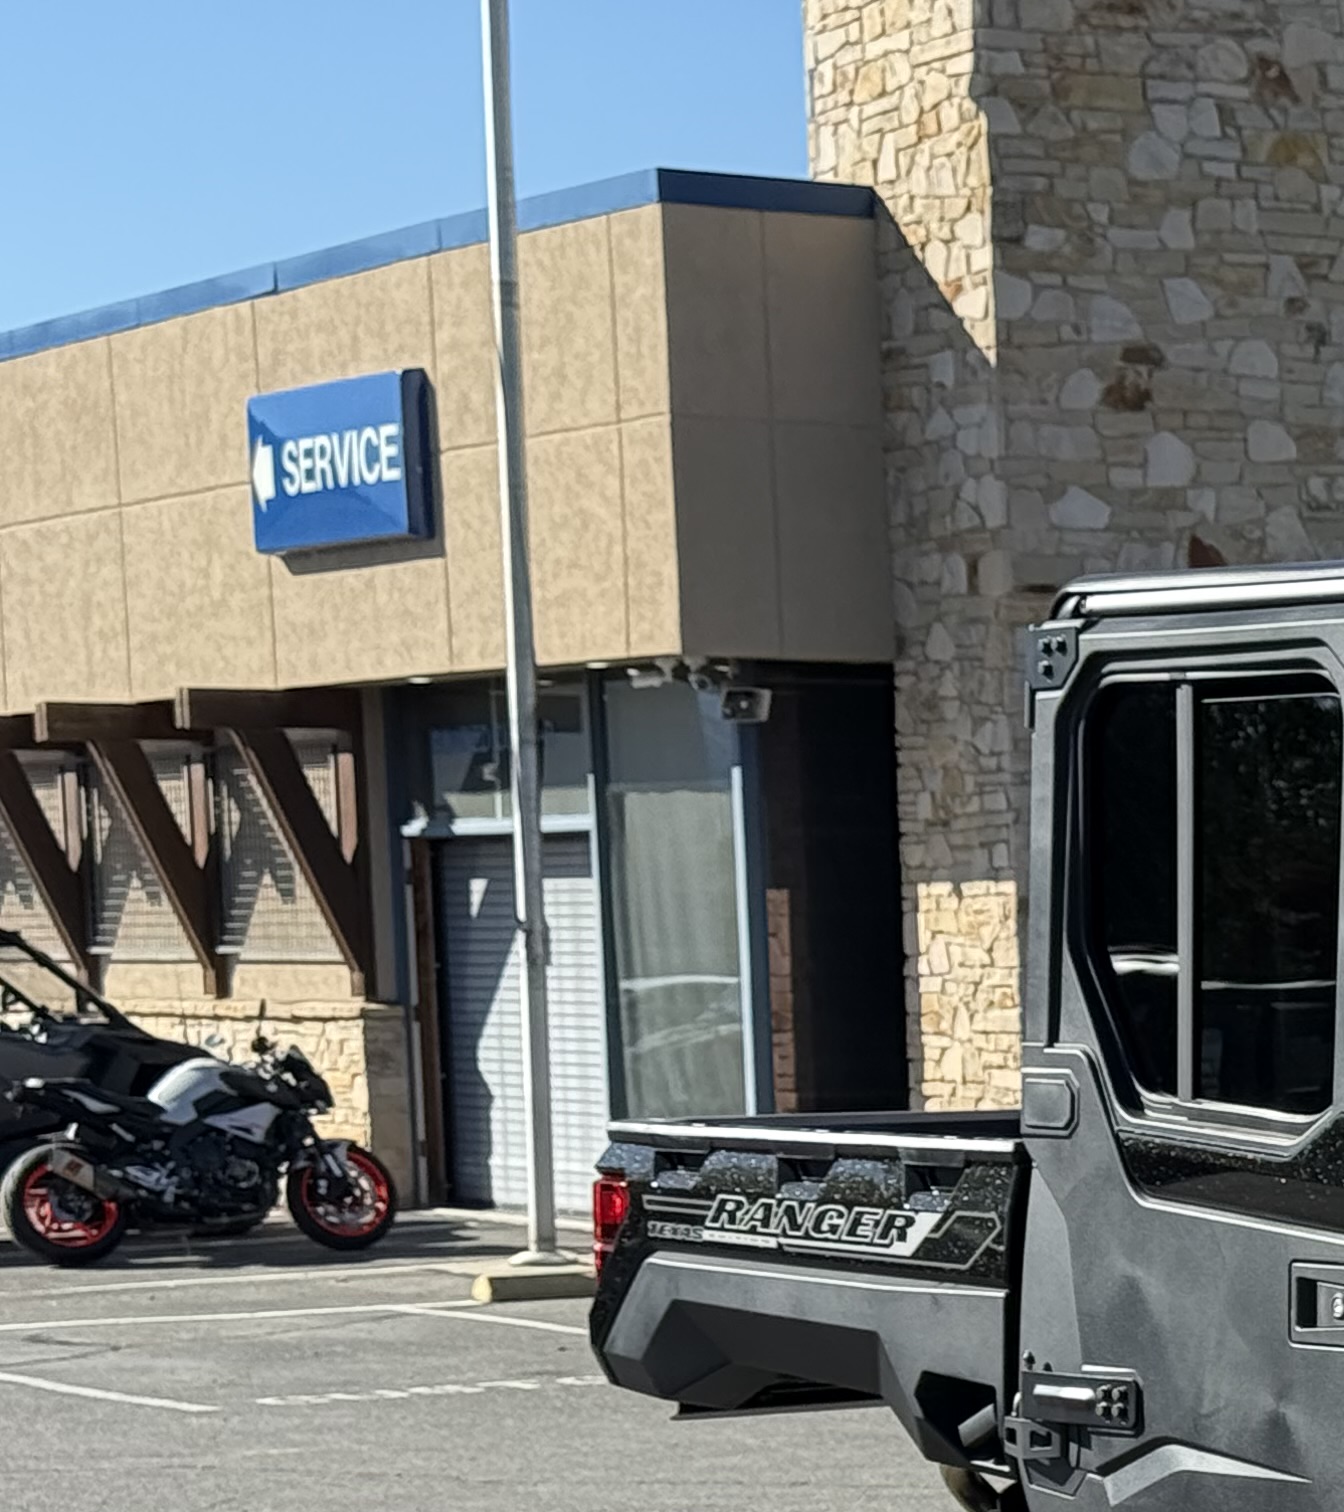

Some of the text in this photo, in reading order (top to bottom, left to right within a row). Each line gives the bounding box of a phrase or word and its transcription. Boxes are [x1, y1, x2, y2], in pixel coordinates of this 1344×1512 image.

[281, 422, 401, 497] SERVICE
[647, 1220, 704, 1242] TEXAS
[704, 1194, 916, 1248] RANGER
